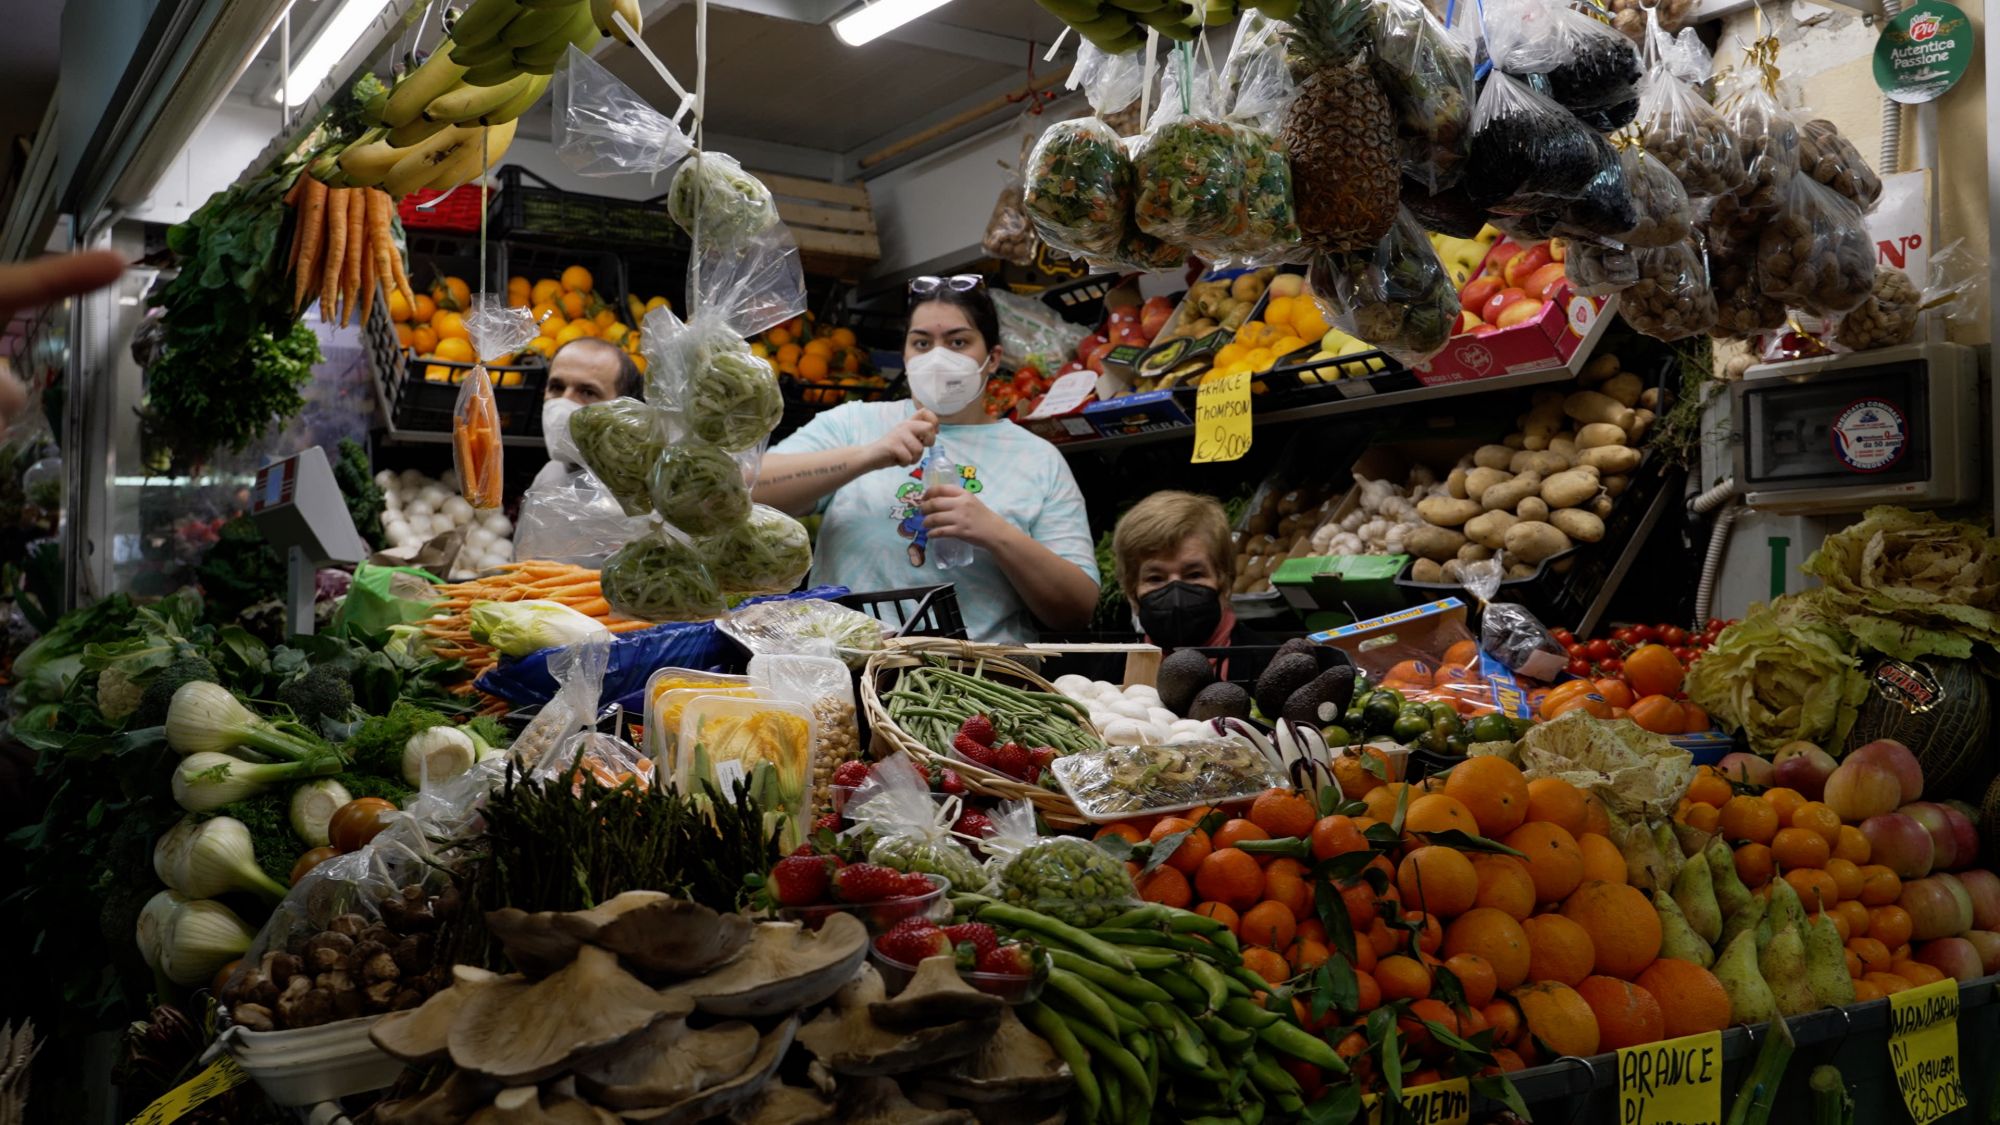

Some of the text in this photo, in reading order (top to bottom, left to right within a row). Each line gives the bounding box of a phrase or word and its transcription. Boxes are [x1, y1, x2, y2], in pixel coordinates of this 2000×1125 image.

[1890, 39, 1955, 59] Autentica
[1894, 51, 1949, 69] Passione
[1893, 1041, 1908, 1069] DI
[1623, 1047, 1713, 1098] ARANCE
[1626, 1097, 1645, 1125] DI
